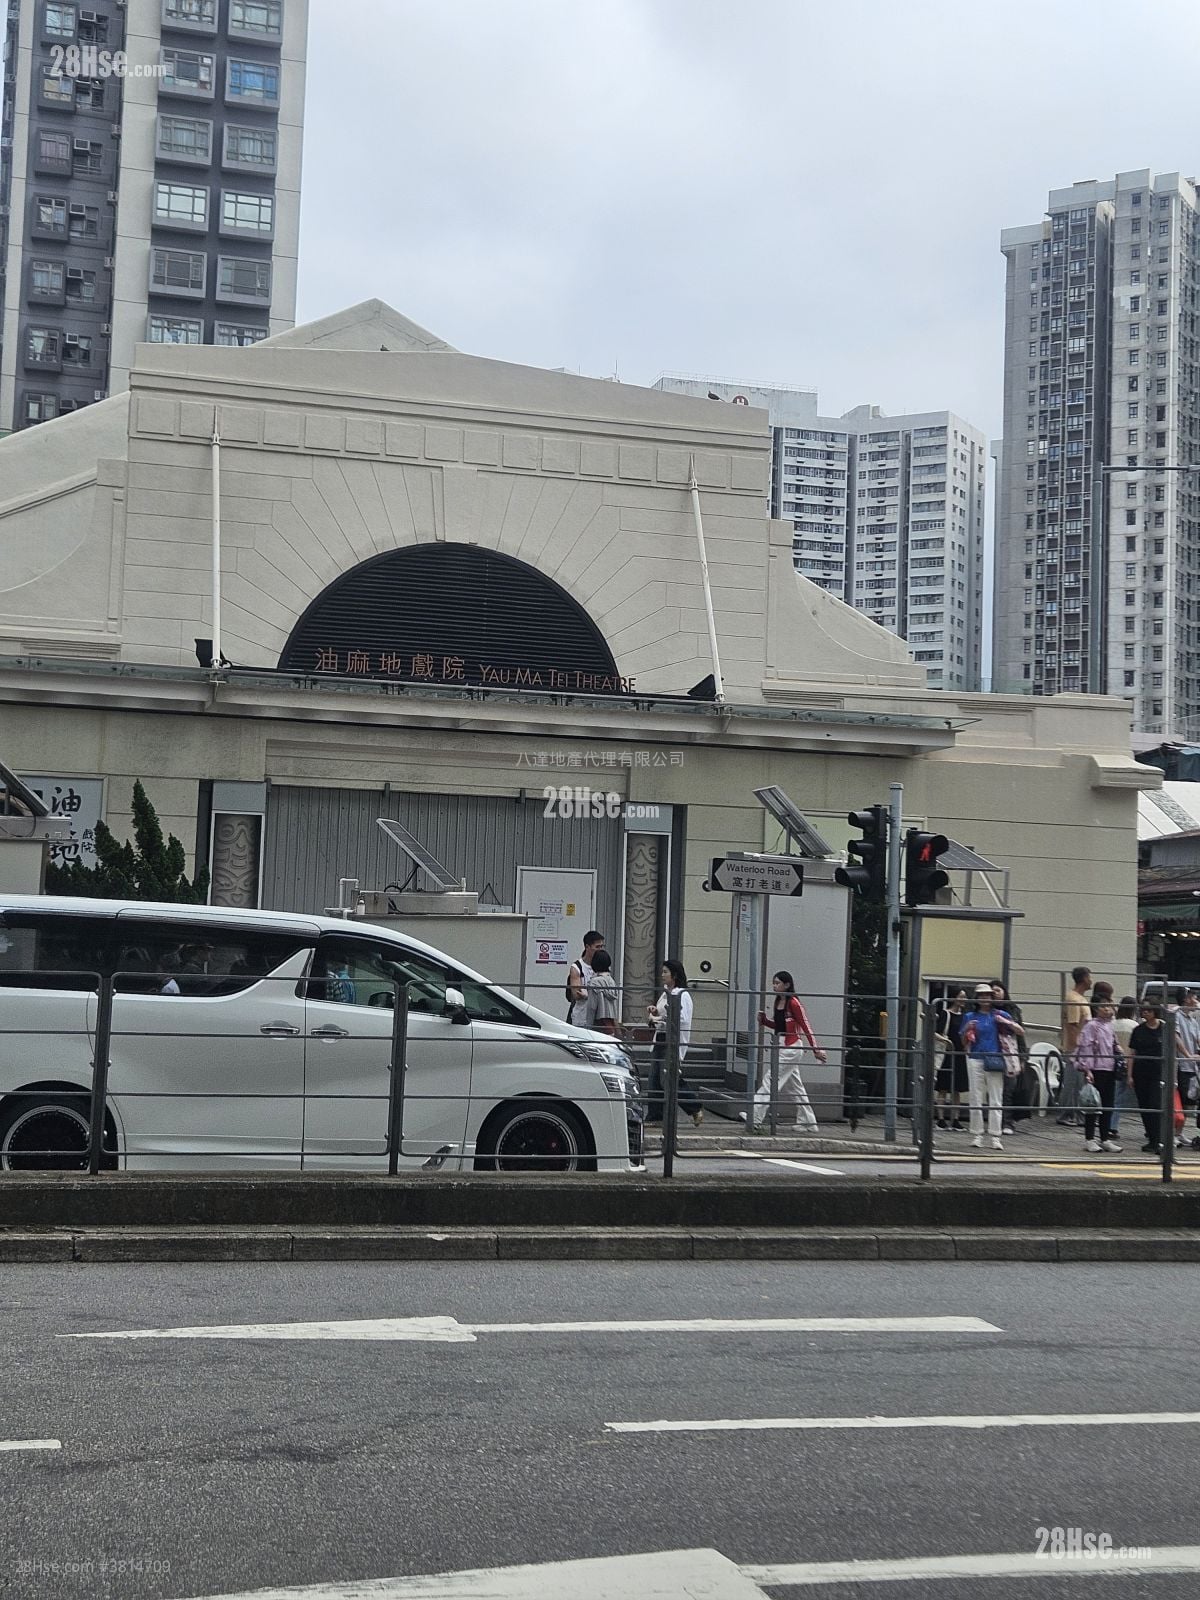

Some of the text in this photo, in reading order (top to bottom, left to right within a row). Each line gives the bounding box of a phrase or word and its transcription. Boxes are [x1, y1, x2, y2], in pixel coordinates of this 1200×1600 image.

[314, 647, 465, 680] 油麻地戲院
[479, 664, 637, 693] YAU MA TEI THEATRE
[51, 786, 82, 862] 油地
[726, 863, 791, 876] Waterloo Road
[732, 876, 782, 890] 窩打老道
